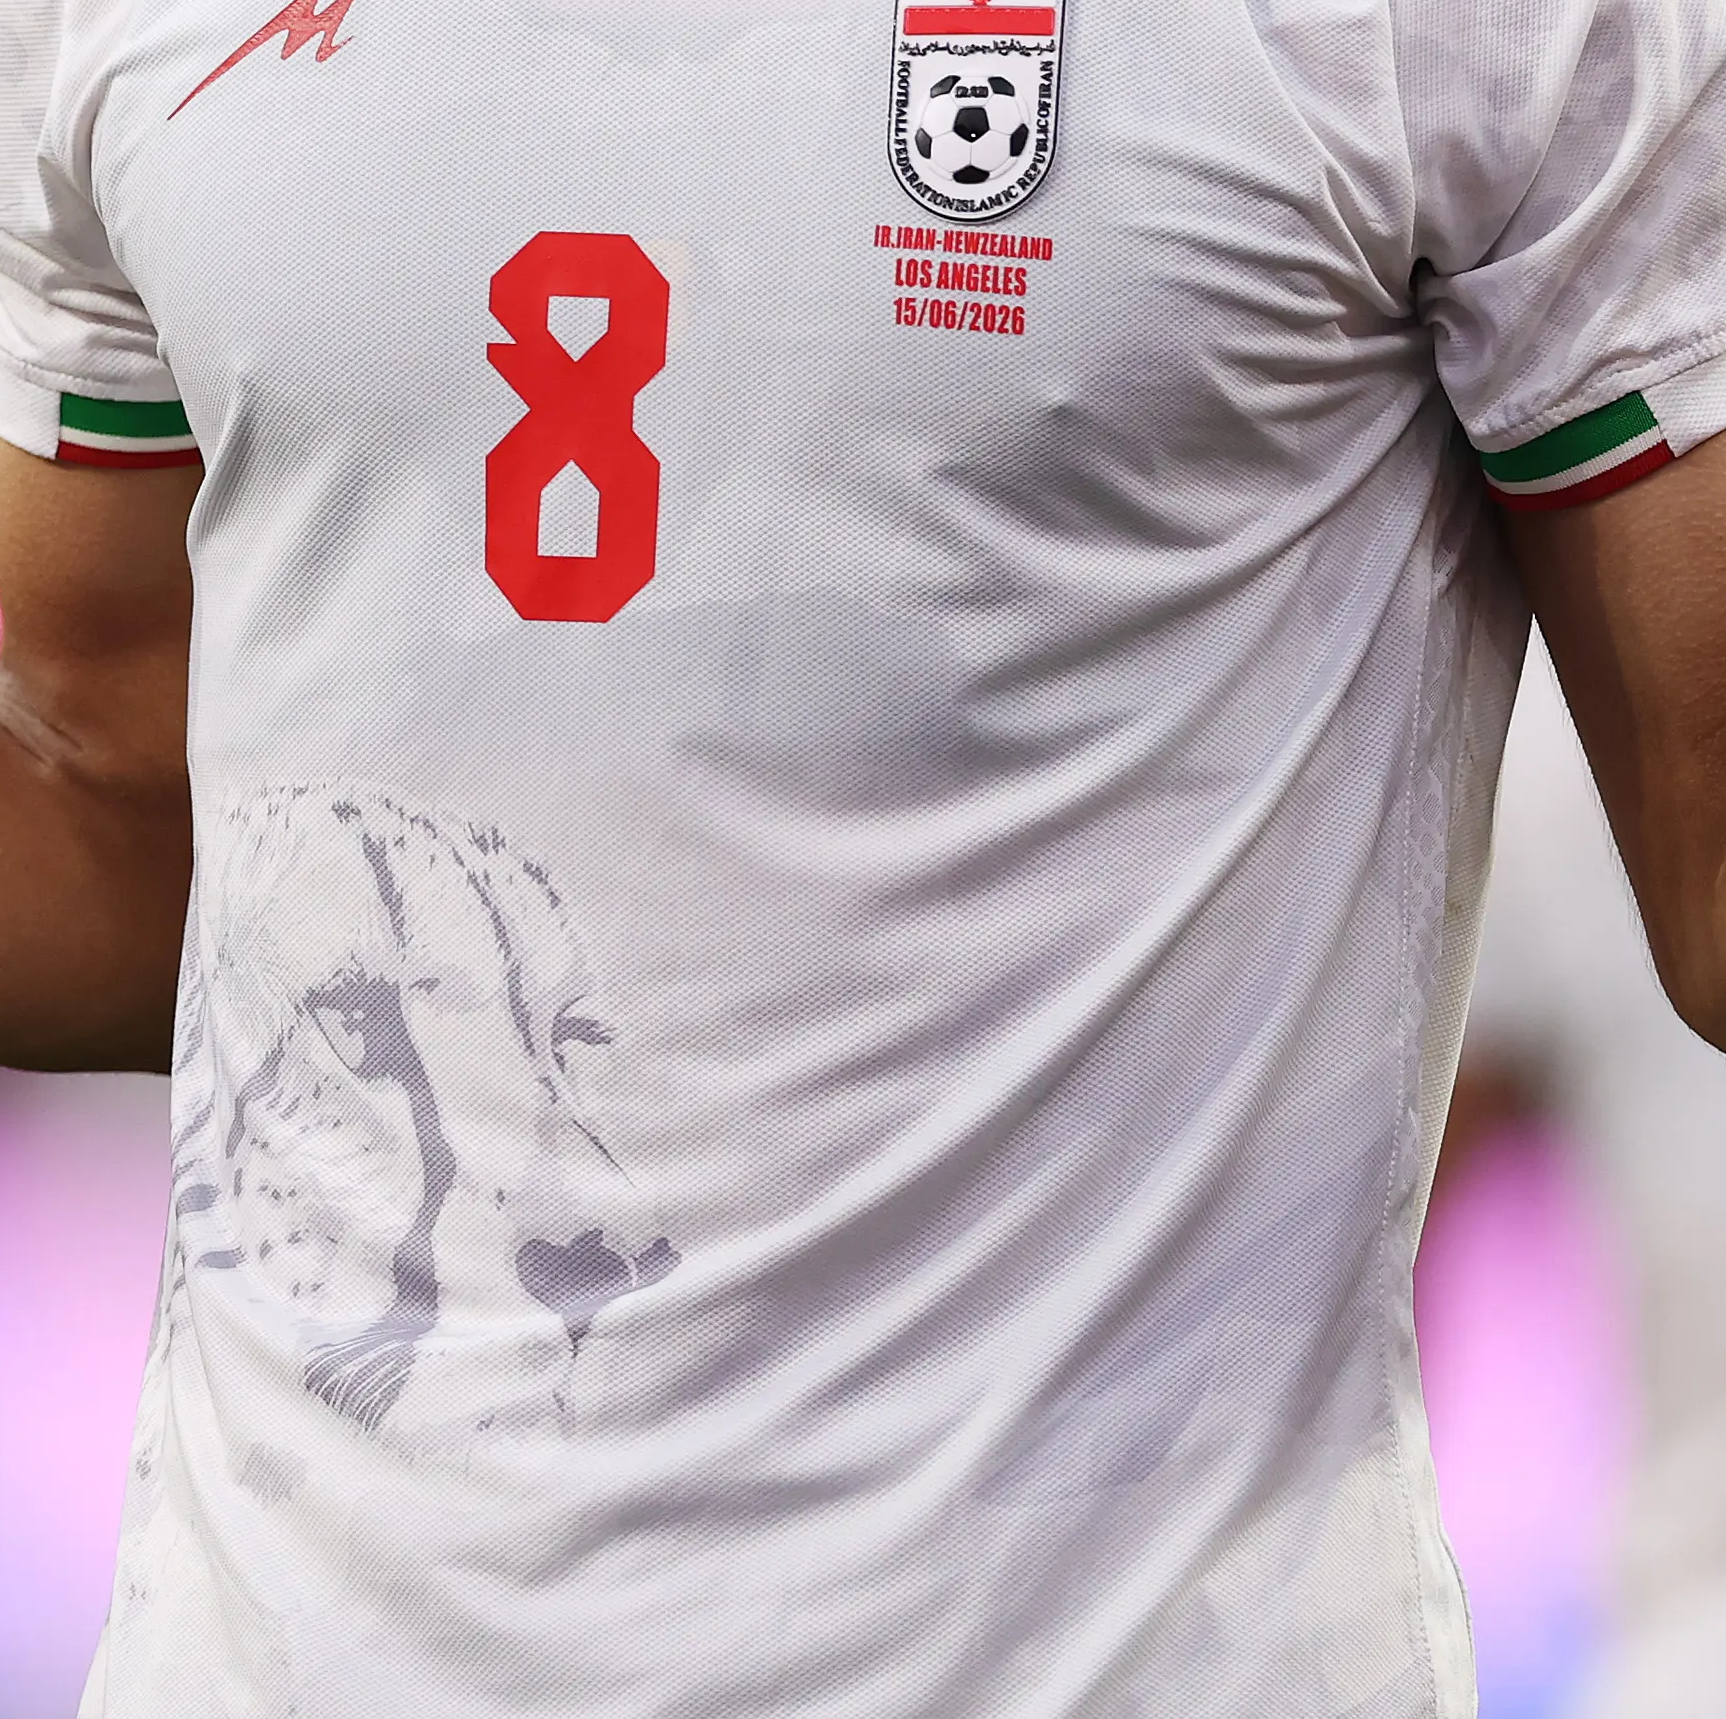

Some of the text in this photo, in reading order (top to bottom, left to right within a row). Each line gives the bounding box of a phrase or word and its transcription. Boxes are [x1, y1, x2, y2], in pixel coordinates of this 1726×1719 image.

[893, 60, 911, 138] FOOTBALL
[894, 258, 1028, 297] LOS ANGELES
[893, 296, 1026, 336] 15/06/2026
[484, 230, 671, 624] 8
